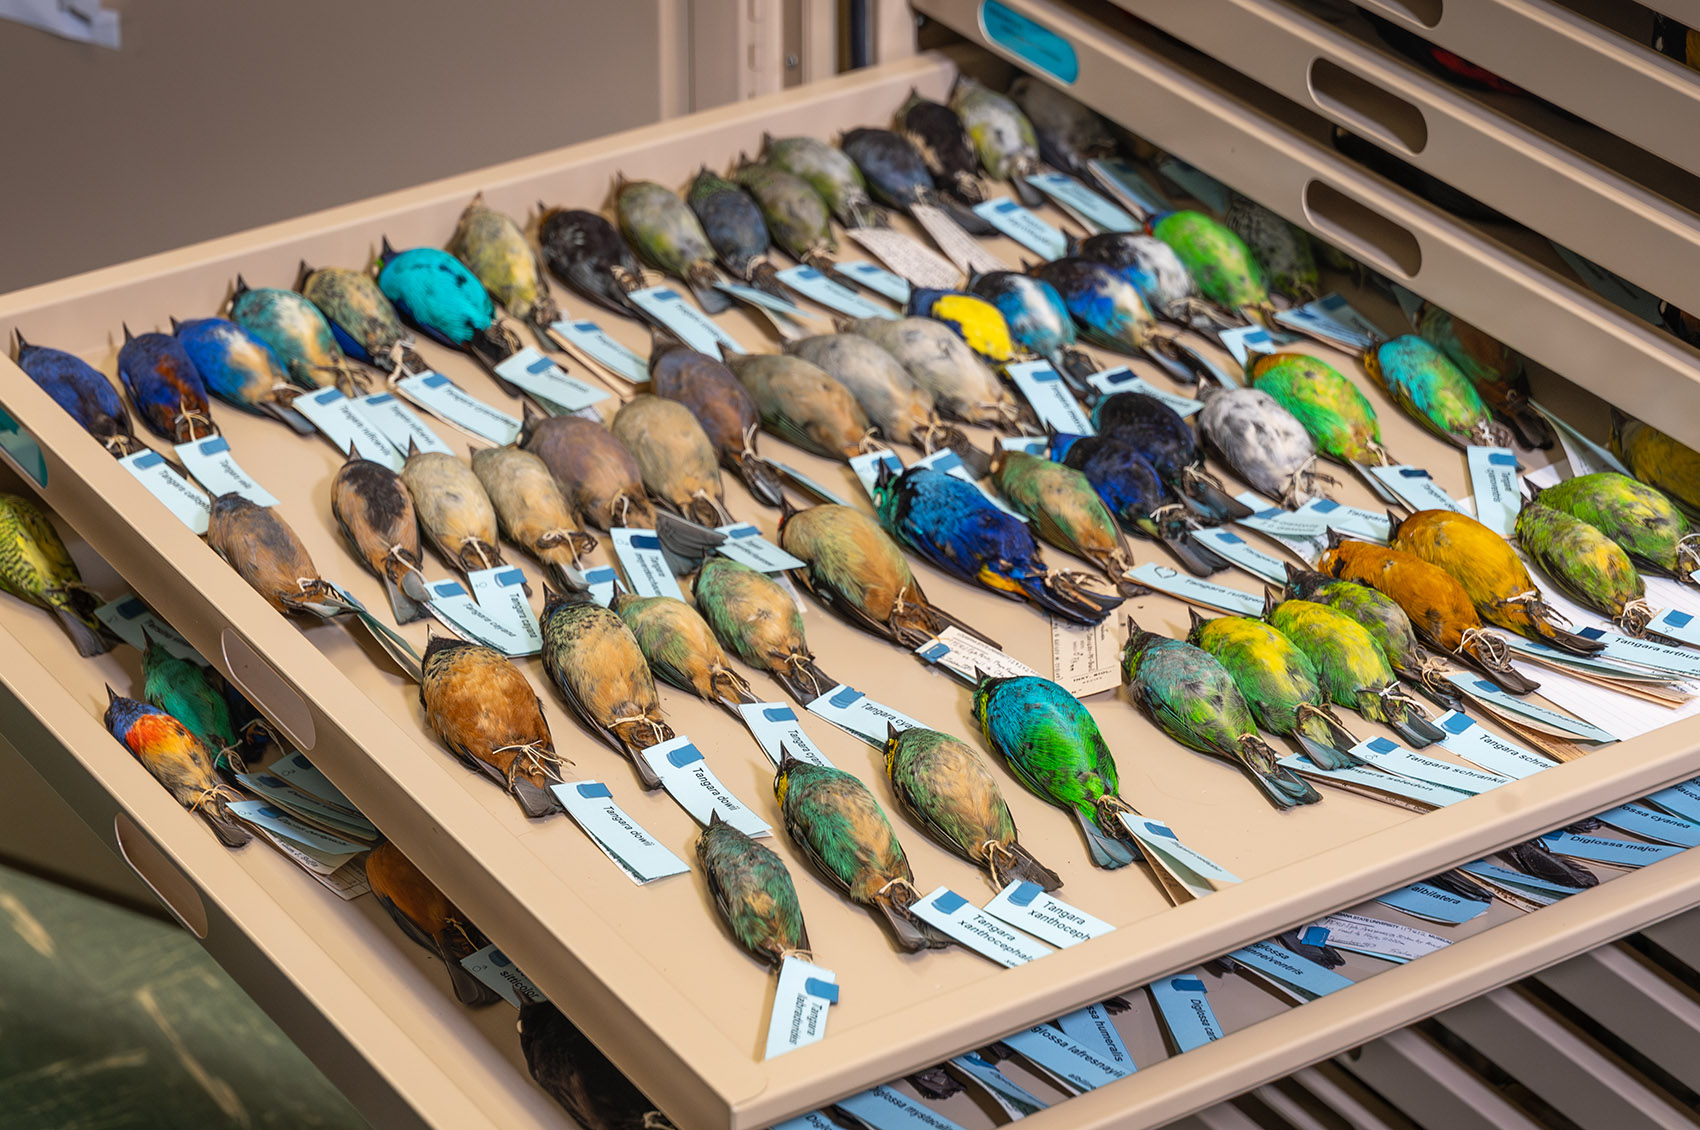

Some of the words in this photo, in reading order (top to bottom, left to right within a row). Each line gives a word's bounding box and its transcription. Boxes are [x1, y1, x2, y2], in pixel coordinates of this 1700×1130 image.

[158, 469, 186, 494] Tangara
[509, 592, 527, 620] Tangara
[521, 618, 538, 639] cayana
[1614, 637, 1661, 653] Tangara
[1662, 649, 1700, 661] arthus
[861, 702, 896, 722] Tangara
[788, 729, 809, 753] Tangara
[1480, 733, 1518, 758] Tangara
[1405, 752, 1451, 772] Tangara
[1451, 767, 1508, 785] schrankii
[692, 767, 719, 797] Tangara
[717, 792, 740, 811] dowii
[603, 805, 632, 833] Tangara
[630, 829, 655, 847] dowii
[1650, 814, 1692, 829] cyanea
[1570, 835, 1623, 849] Diglossa
[1625, 844, 1662, 854] major
[1411, 885, 1461, 905] albilatera
[1043, 901, 1086, 926] Tangara
[973, 914, 1016, 942] Tangara
[500, 969, 539, 999] sitticolor
[789, 993, 808, 1045] labradorides
[806, 1002, 823, 1036] Tangara
[1190, 998, 1210, 1026] Diglossa
[1031, 1024, 1068, 1050] glossa
[1067, 1044, 1126, 1079] lafresnayii
[1094, 1019, 1124, 1062] humeralis
